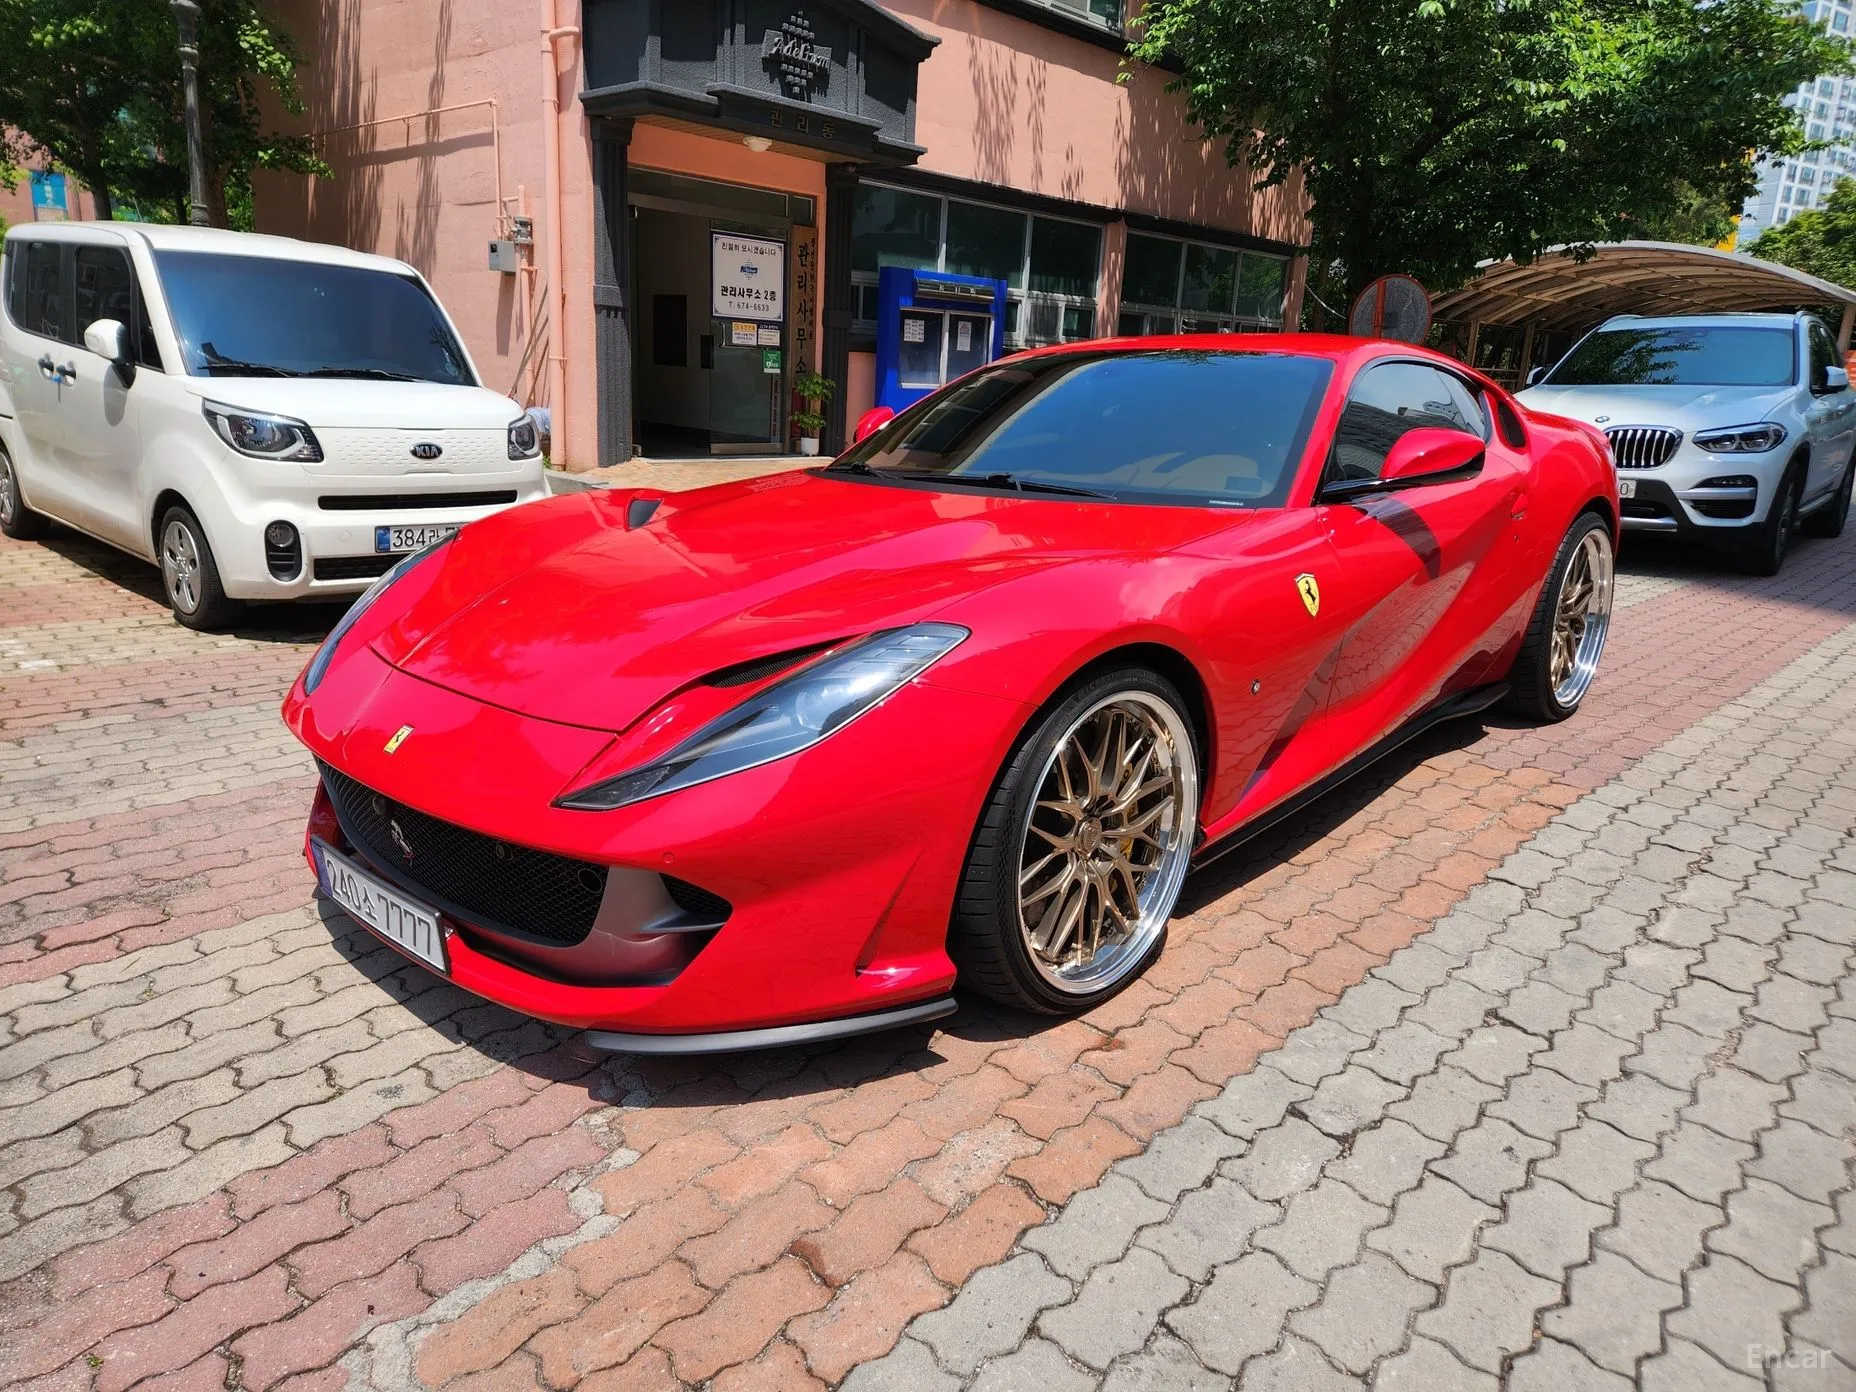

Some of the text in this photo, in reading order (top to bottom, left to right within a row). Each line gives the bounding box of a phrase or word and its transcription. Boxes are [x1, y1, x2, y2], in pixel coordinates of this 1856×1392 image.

[771, 109, 835, 139] 관리동
[721, 241, 777, 257] 친절히 모시겠습니다
[720, 285, 777, 302] 관리사무소 2층
[795, 242, 809, 374] 관리사무소
[415, 445, 440, 457] KIA
